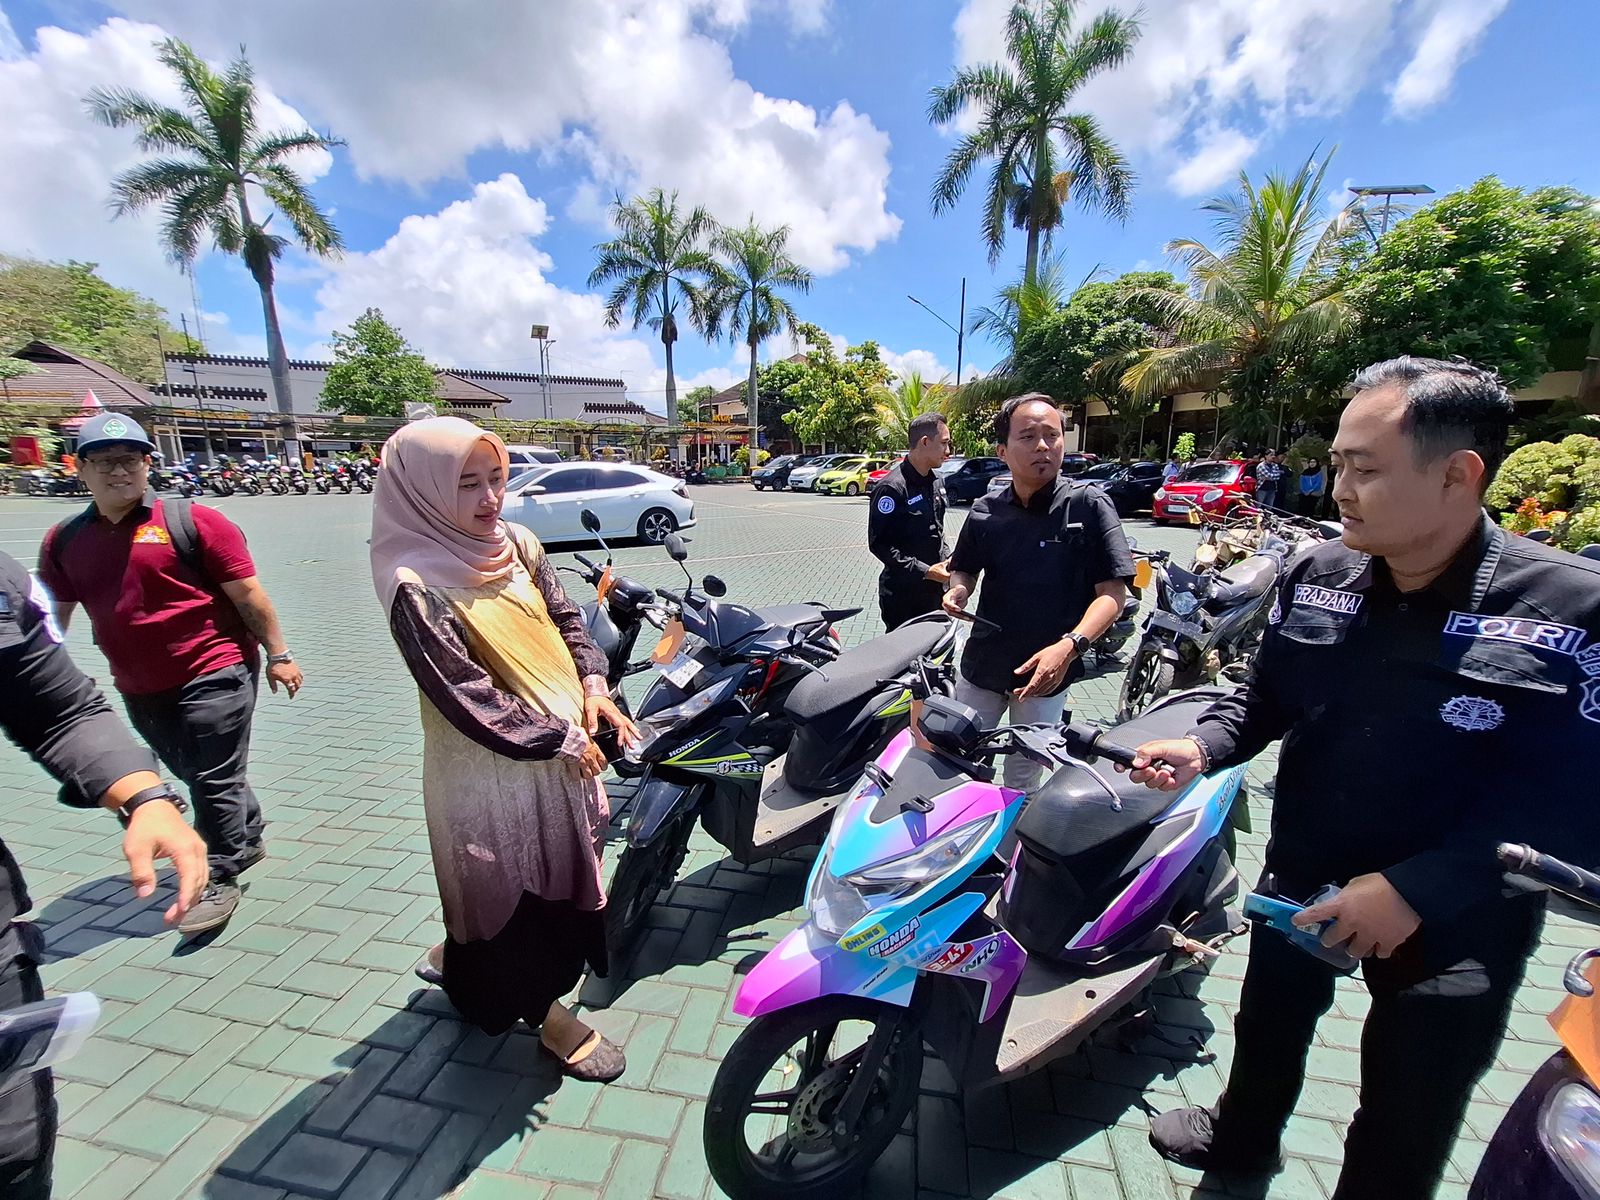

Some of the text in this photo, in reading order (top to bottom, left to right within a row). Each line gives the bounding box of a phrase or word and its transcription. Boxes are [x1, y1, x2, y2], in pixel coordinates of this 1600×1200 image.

[1296, 586, 1357, 612] PRADANA
[1450, 614, 1577, 652] POLRI
[668, 738, 701, 757] HONDA
[869, 918, 920, 956] HONDA
[884, 934, 911, 955] RACING
